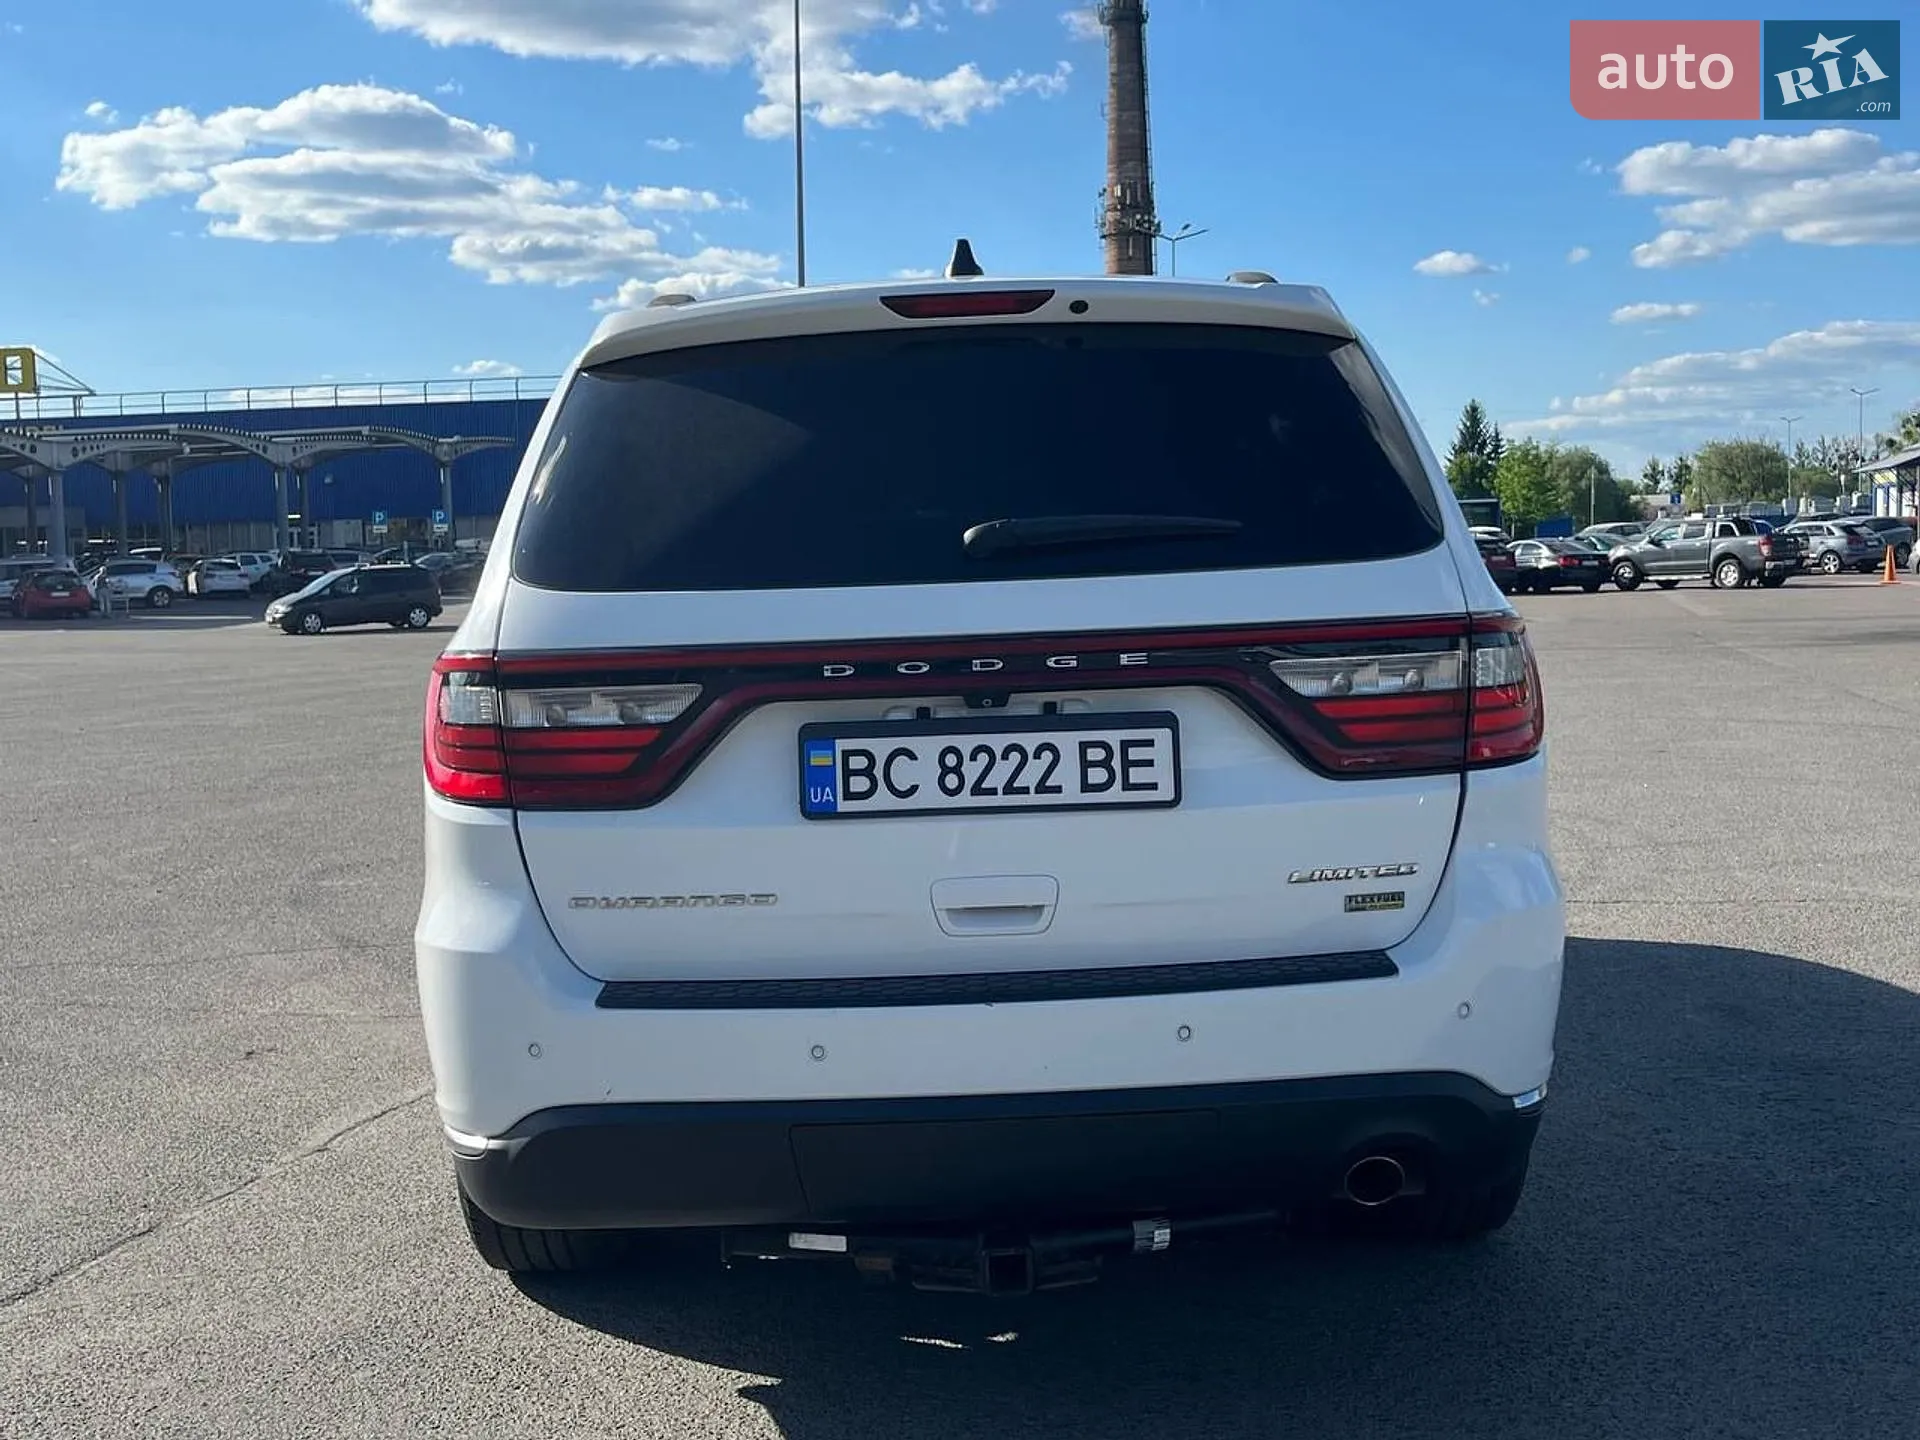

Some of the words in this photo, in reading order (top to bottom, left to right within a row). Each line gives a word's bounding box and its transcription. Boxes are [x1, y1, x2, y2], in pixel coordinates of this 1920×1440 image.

[823, 652, 1150, 678] DODGE
[841, 746, 919, 801] BC
[936, 742, 1063, 797] 8222
[1078, 738, 1159, 793] BE
[810, 786, 834, 803] UA
[1288, 862, 1420, 884] LIMITED
[568, 893, 778, 909] DURANGO
